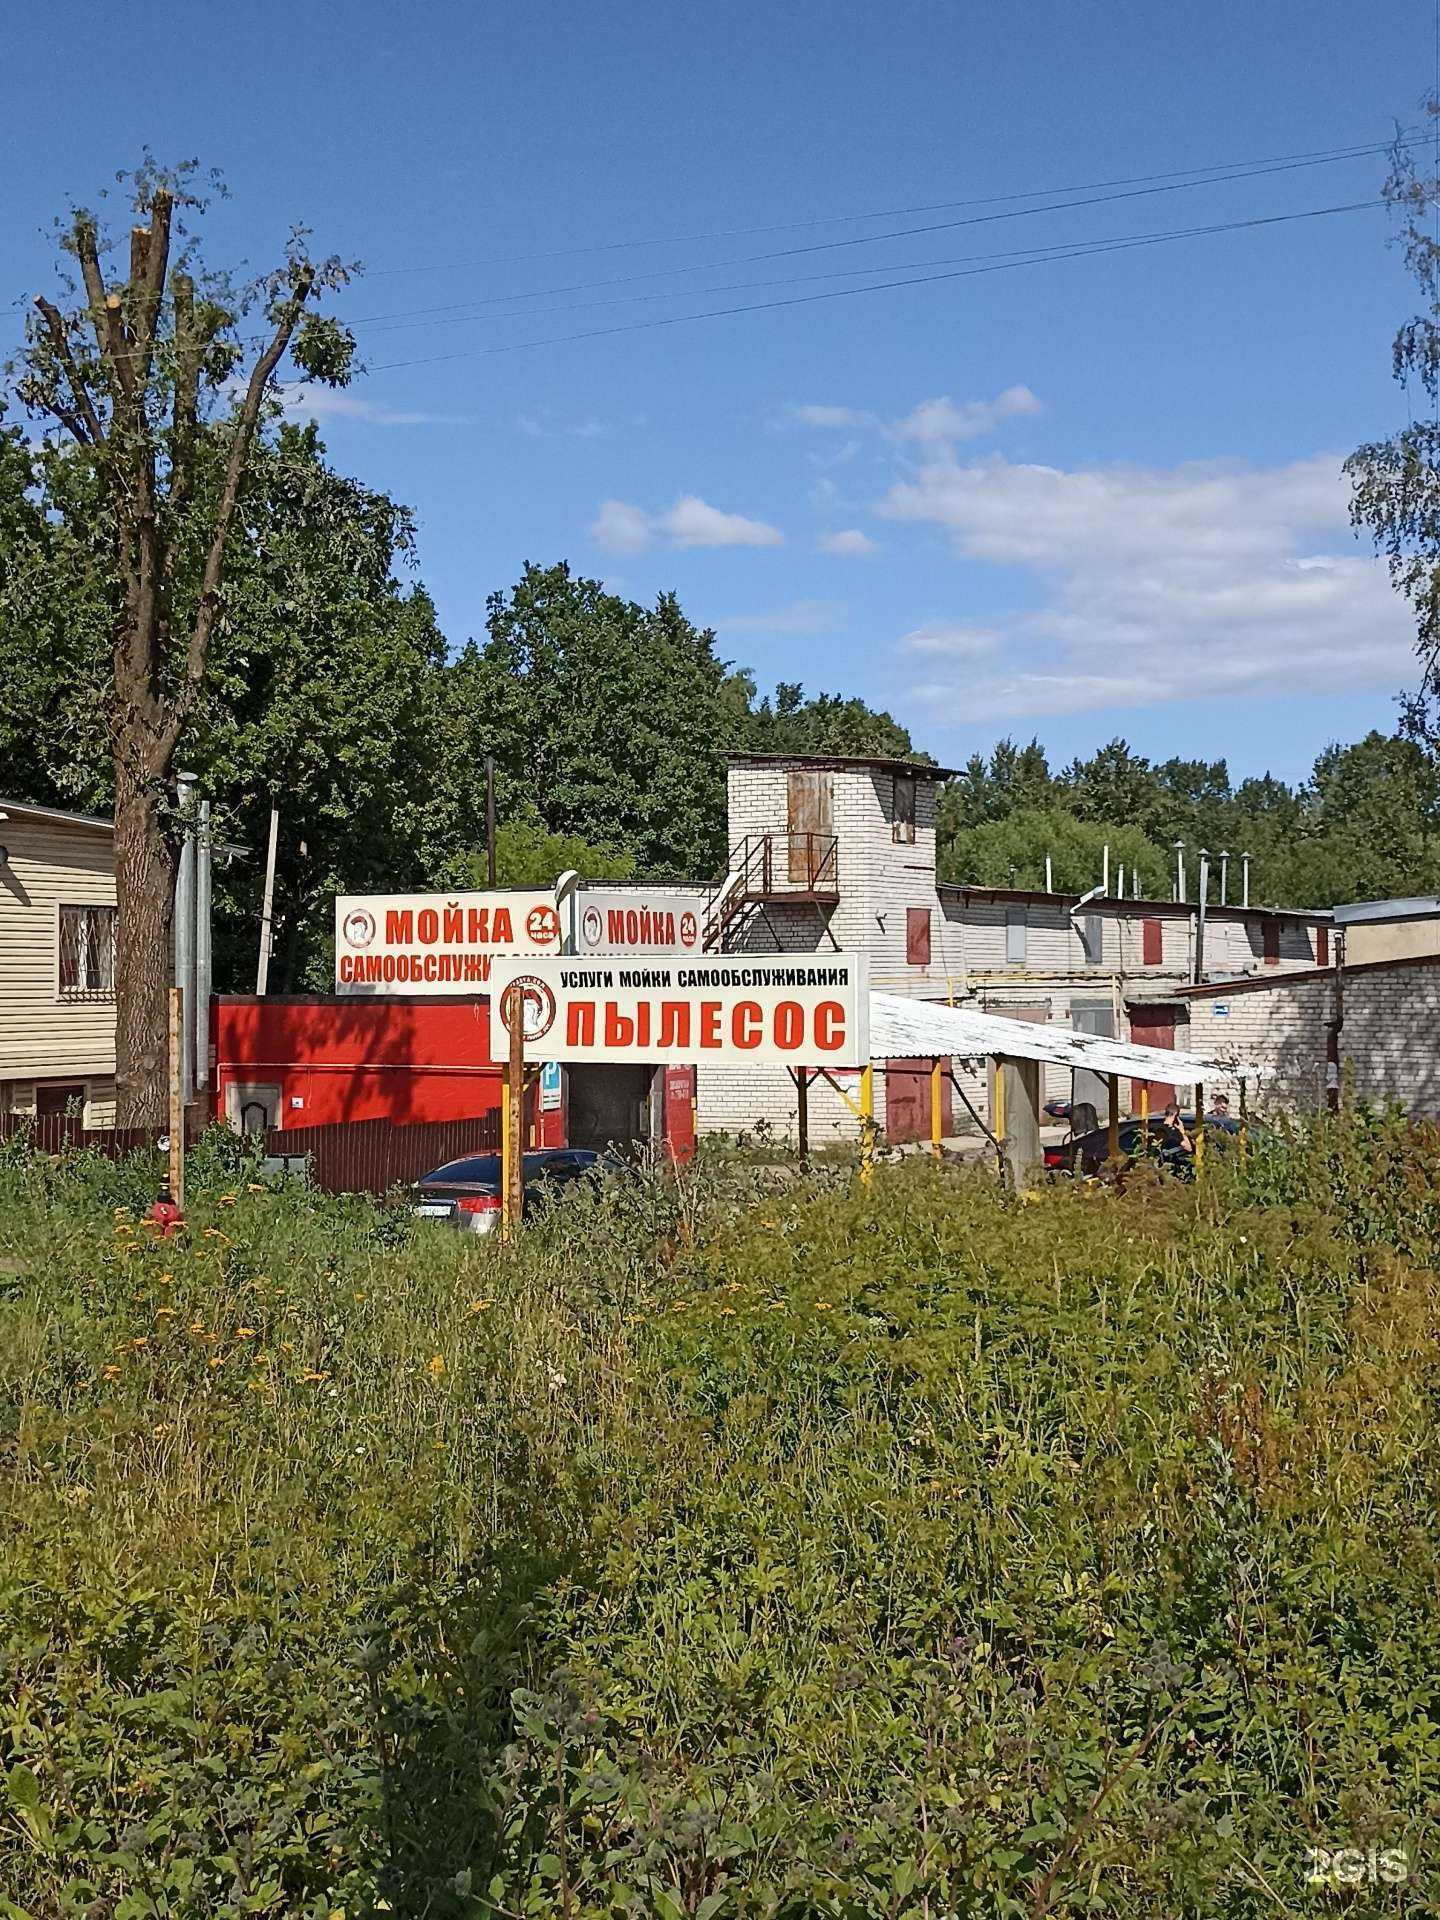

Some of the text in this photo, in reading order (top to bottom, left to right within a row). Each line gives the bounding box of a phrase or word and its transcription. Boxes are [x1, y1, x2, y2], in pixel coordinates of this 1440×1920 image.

[386, 901, 514, 945] МОЙКА
[529, 911, 555, 931] 24
[607, 904, 676, 946] МОЙКА
[681, 917, 695, 935] 24
[560, 970, 614, 989] УСЛУГИ
[619, 967, 672, 988] МОЙКИ
[677, 967, 849, 988] САМООБСЛУЖИВАНИЯ
[565, 1000, 846, 1051] ПЫЛЕСОС
